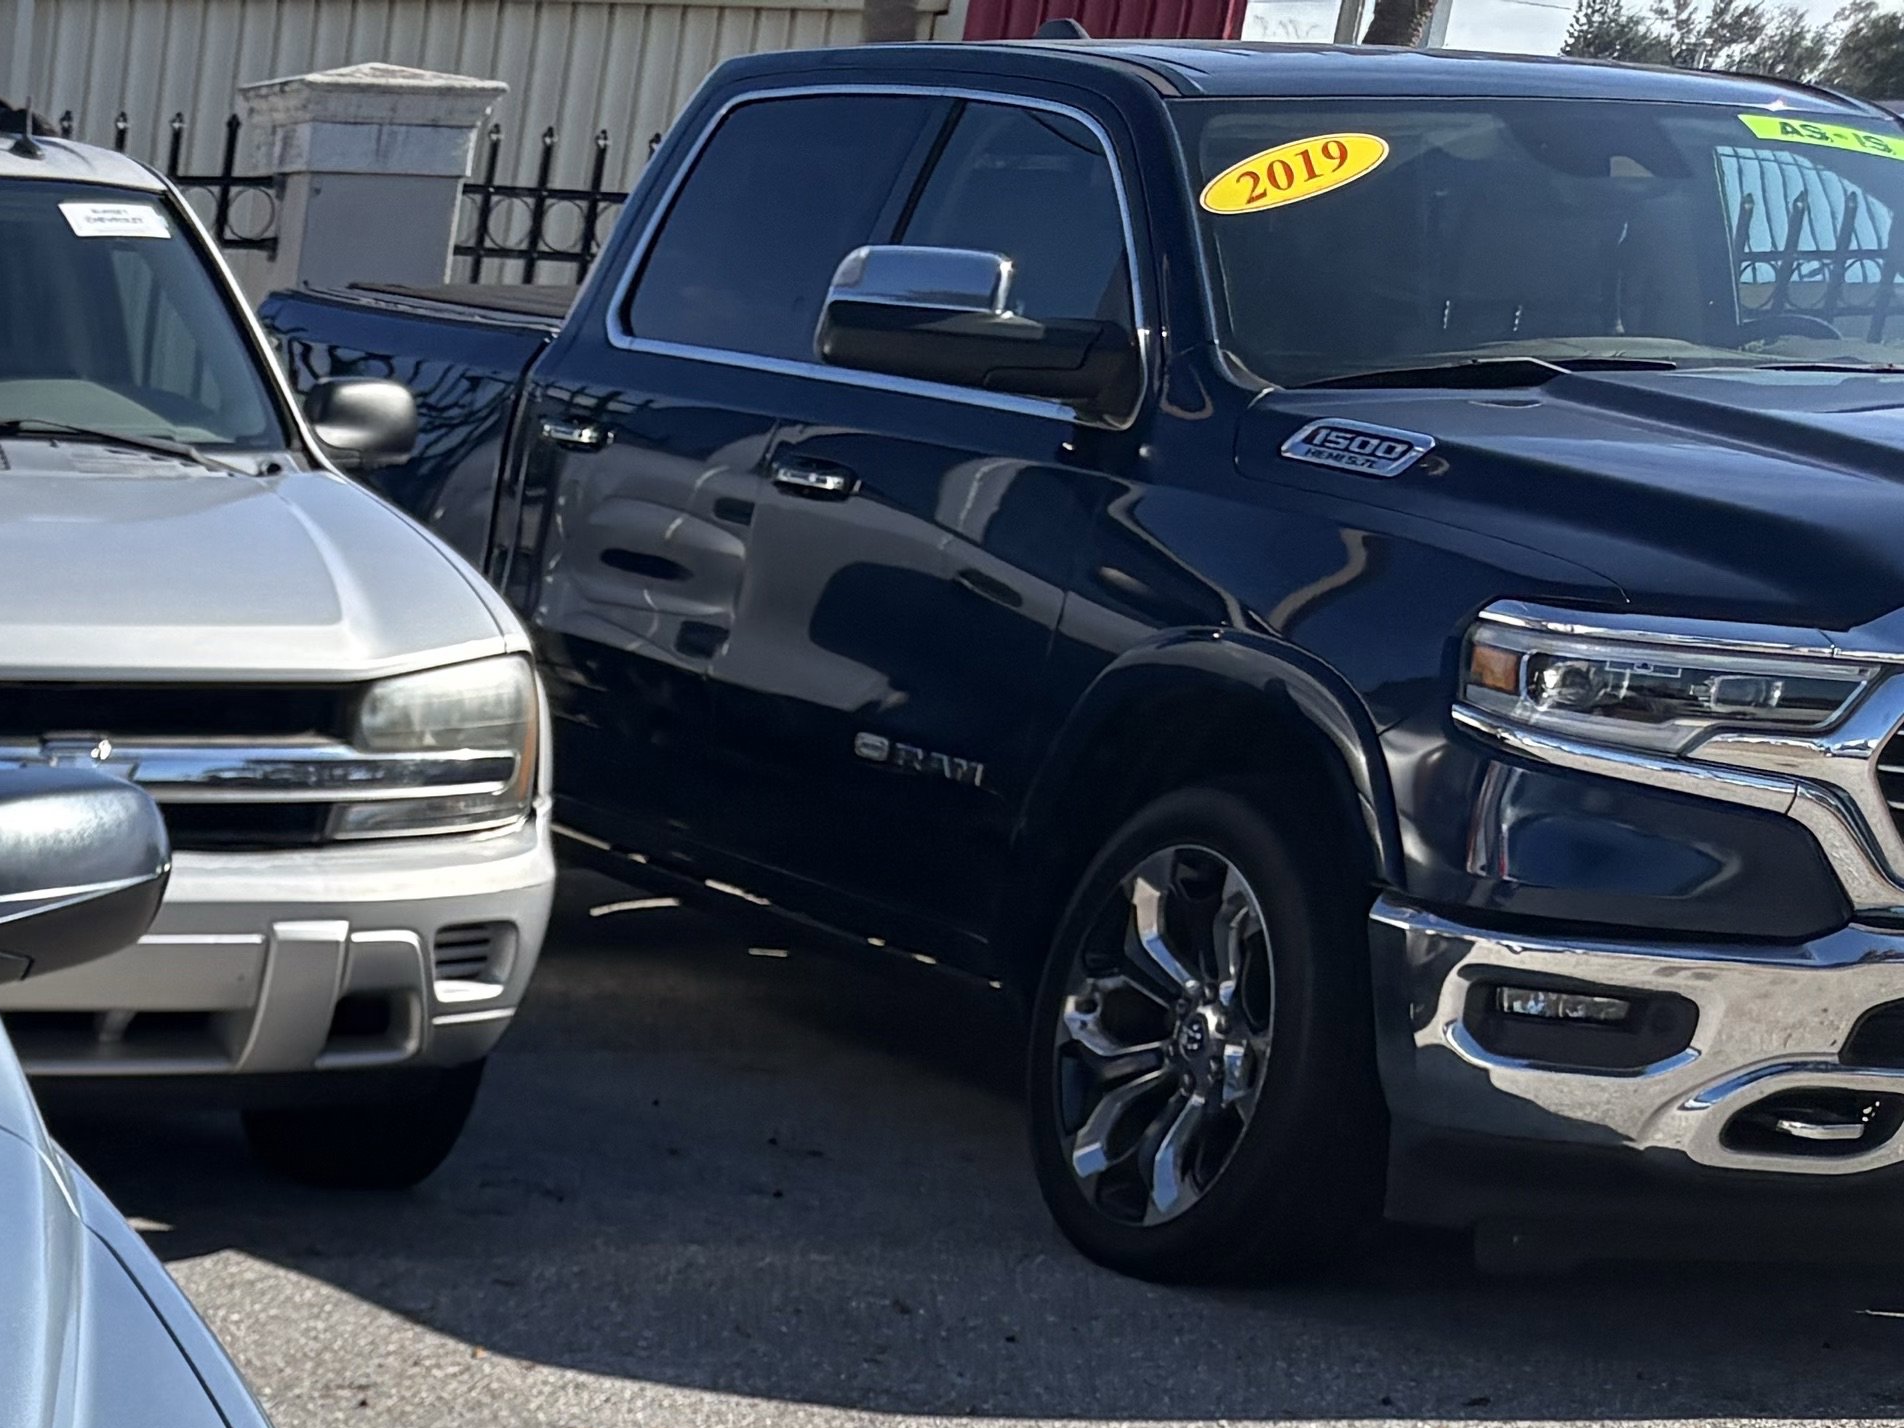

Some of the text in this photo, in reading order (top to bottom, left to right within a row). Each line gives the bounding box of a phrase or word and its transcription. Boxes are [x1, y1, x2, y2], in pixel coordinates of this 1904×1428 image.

[1236, 140, 1348, 205] 2019
[1312, 428, 1410, 459] 1500
[895, 742, 984, 787] RAM
